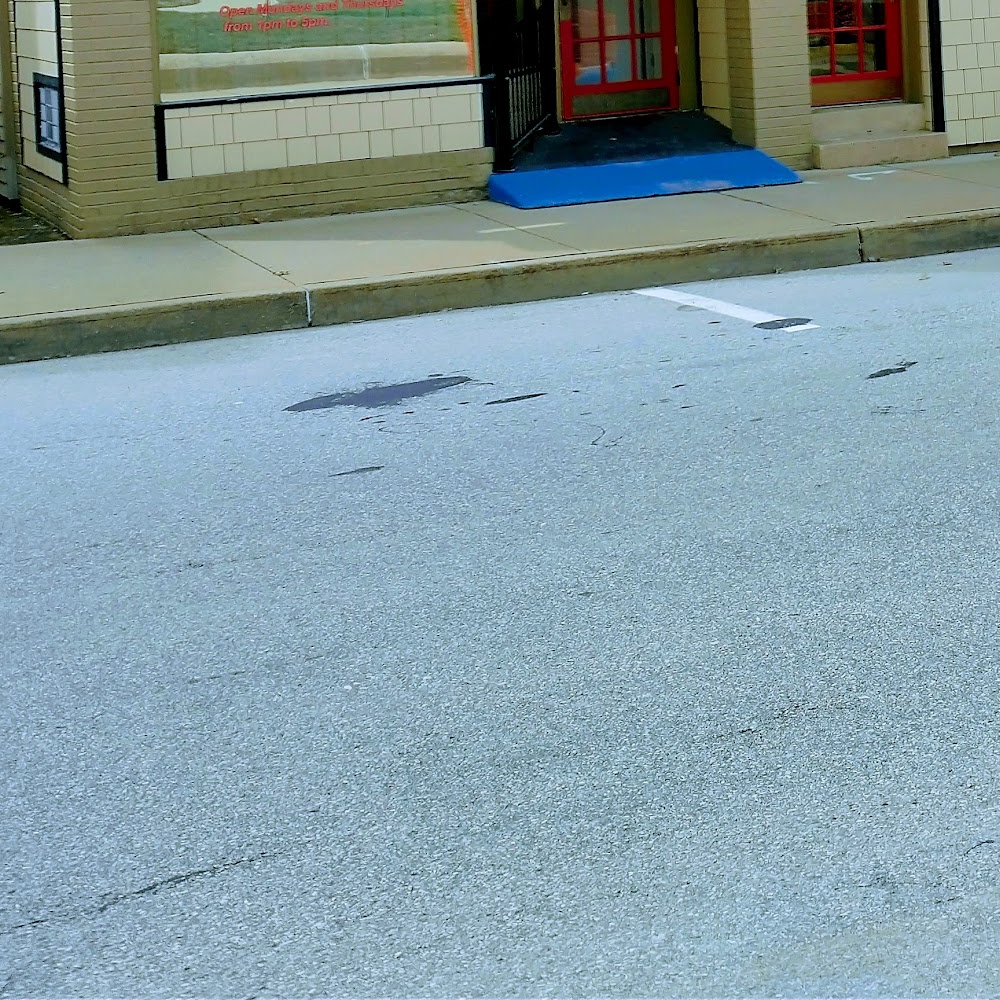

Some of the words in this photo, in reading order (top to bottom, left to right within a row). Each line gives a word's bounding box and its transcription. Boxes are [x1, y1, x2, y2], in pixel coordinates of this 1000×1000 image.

[220, 6, 253, 17] Open
[256, 3, 312, 15] Mondays
[315, 1, 338, 11] and
[224, 21, 252, 32] from
[257, 20, 282, 31] 1pm
[286, 18, 298, 27] to
[302, 17, 328, 28] 5pm
